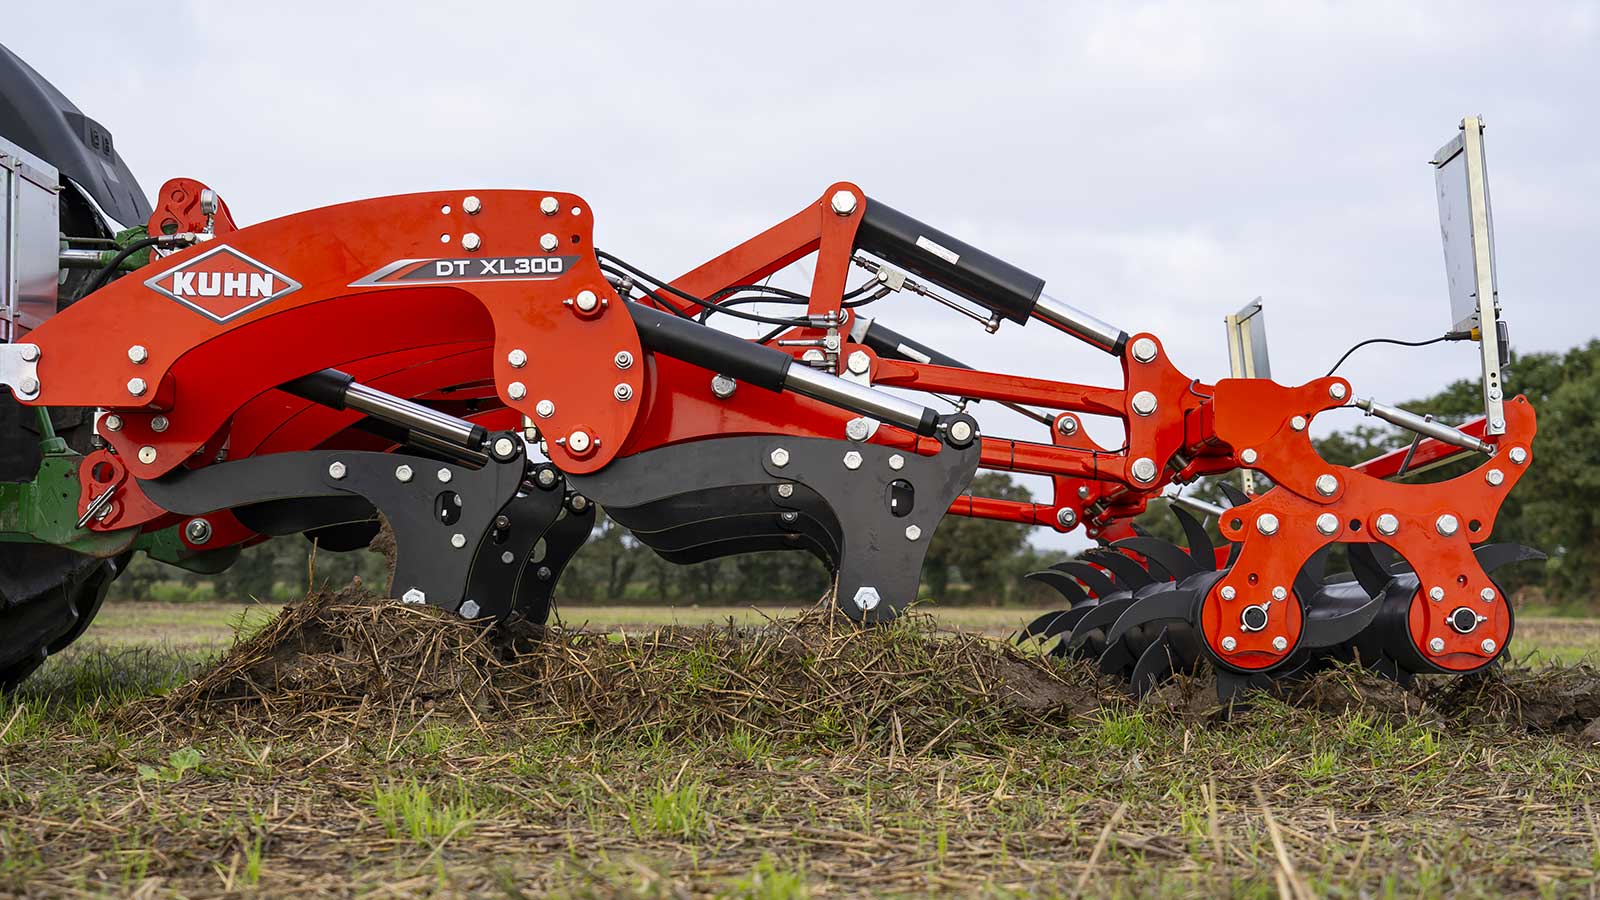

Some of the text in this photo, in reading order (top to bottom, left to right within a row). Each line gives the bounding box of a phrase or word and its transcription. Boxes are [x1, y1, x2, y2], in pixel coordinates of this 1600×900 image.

[436, 257, 563, 276] DT XL300
[173, 271, 274, 297] KUHN
